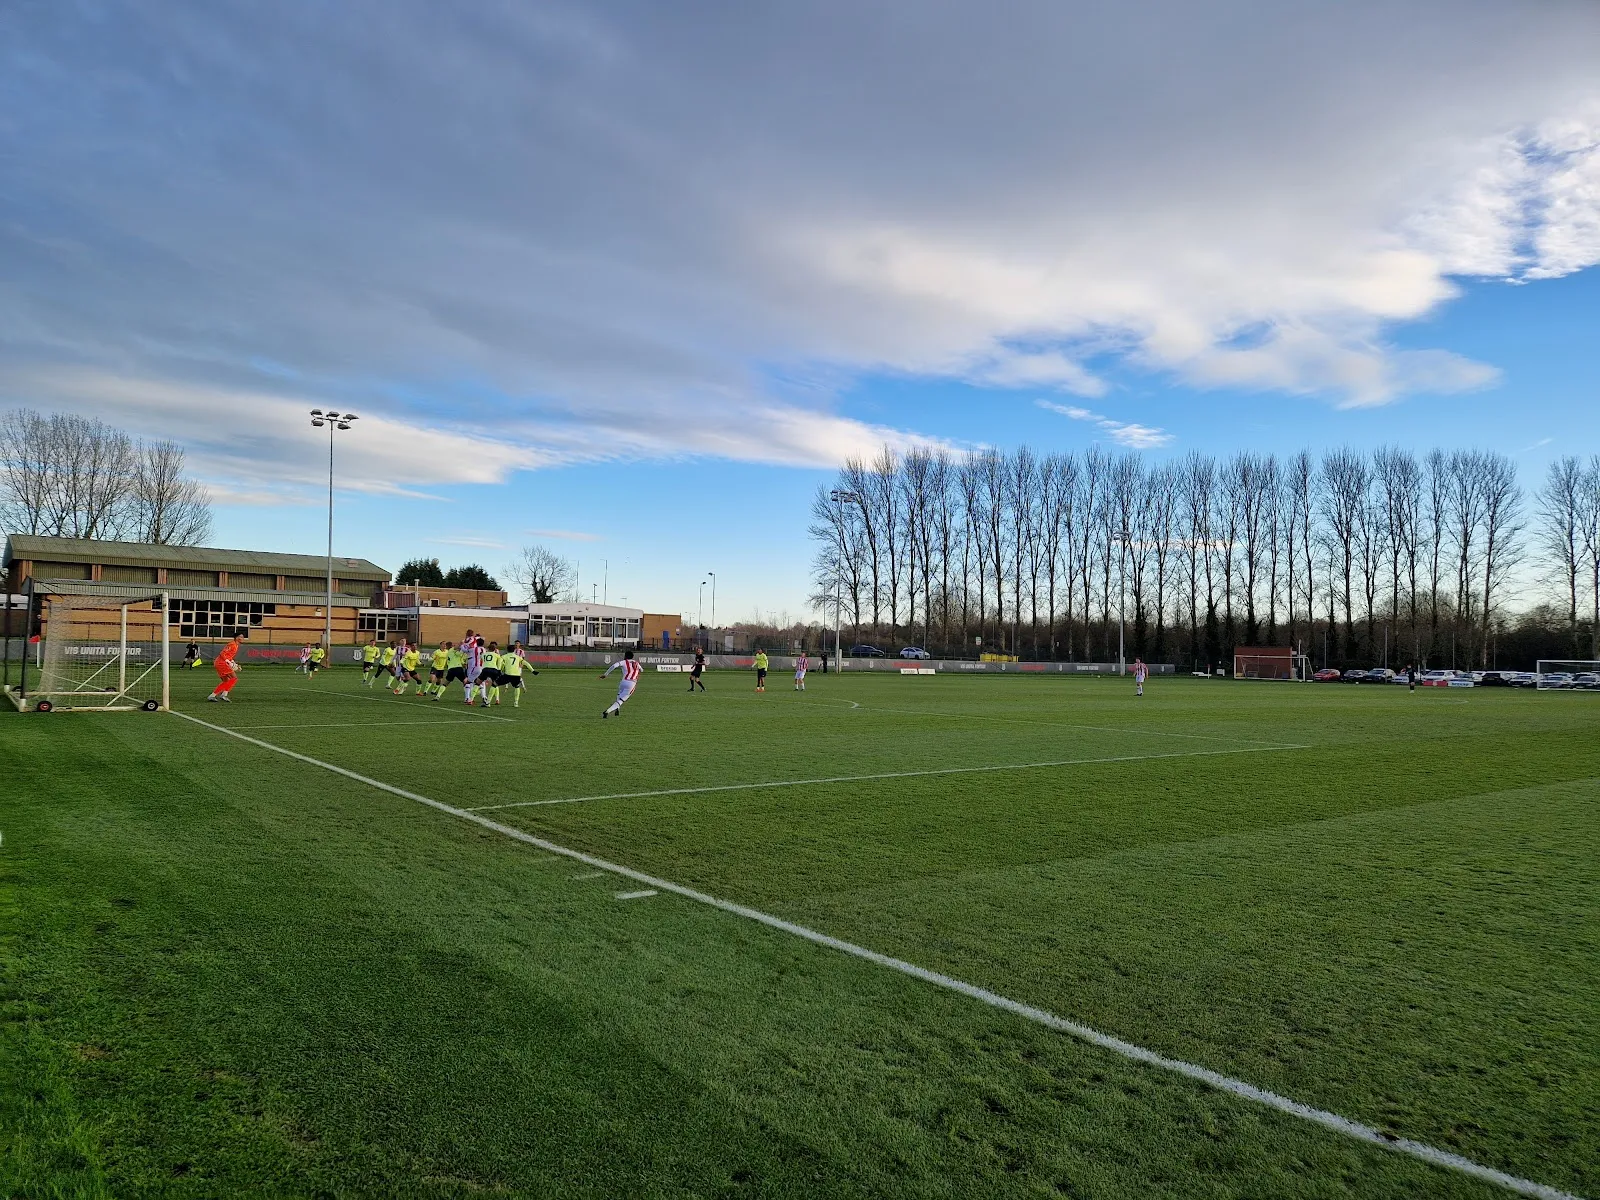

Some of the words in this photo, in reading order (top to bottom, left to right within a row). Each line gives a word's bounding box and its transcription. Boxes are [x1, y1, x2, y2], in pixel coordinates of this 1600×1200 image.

[64, 646, 79, 655] VIS
[80, 646, 105, 655] UNITA
[483, 654, 493, 662] 10
[510, 657, 516, 665] 7
